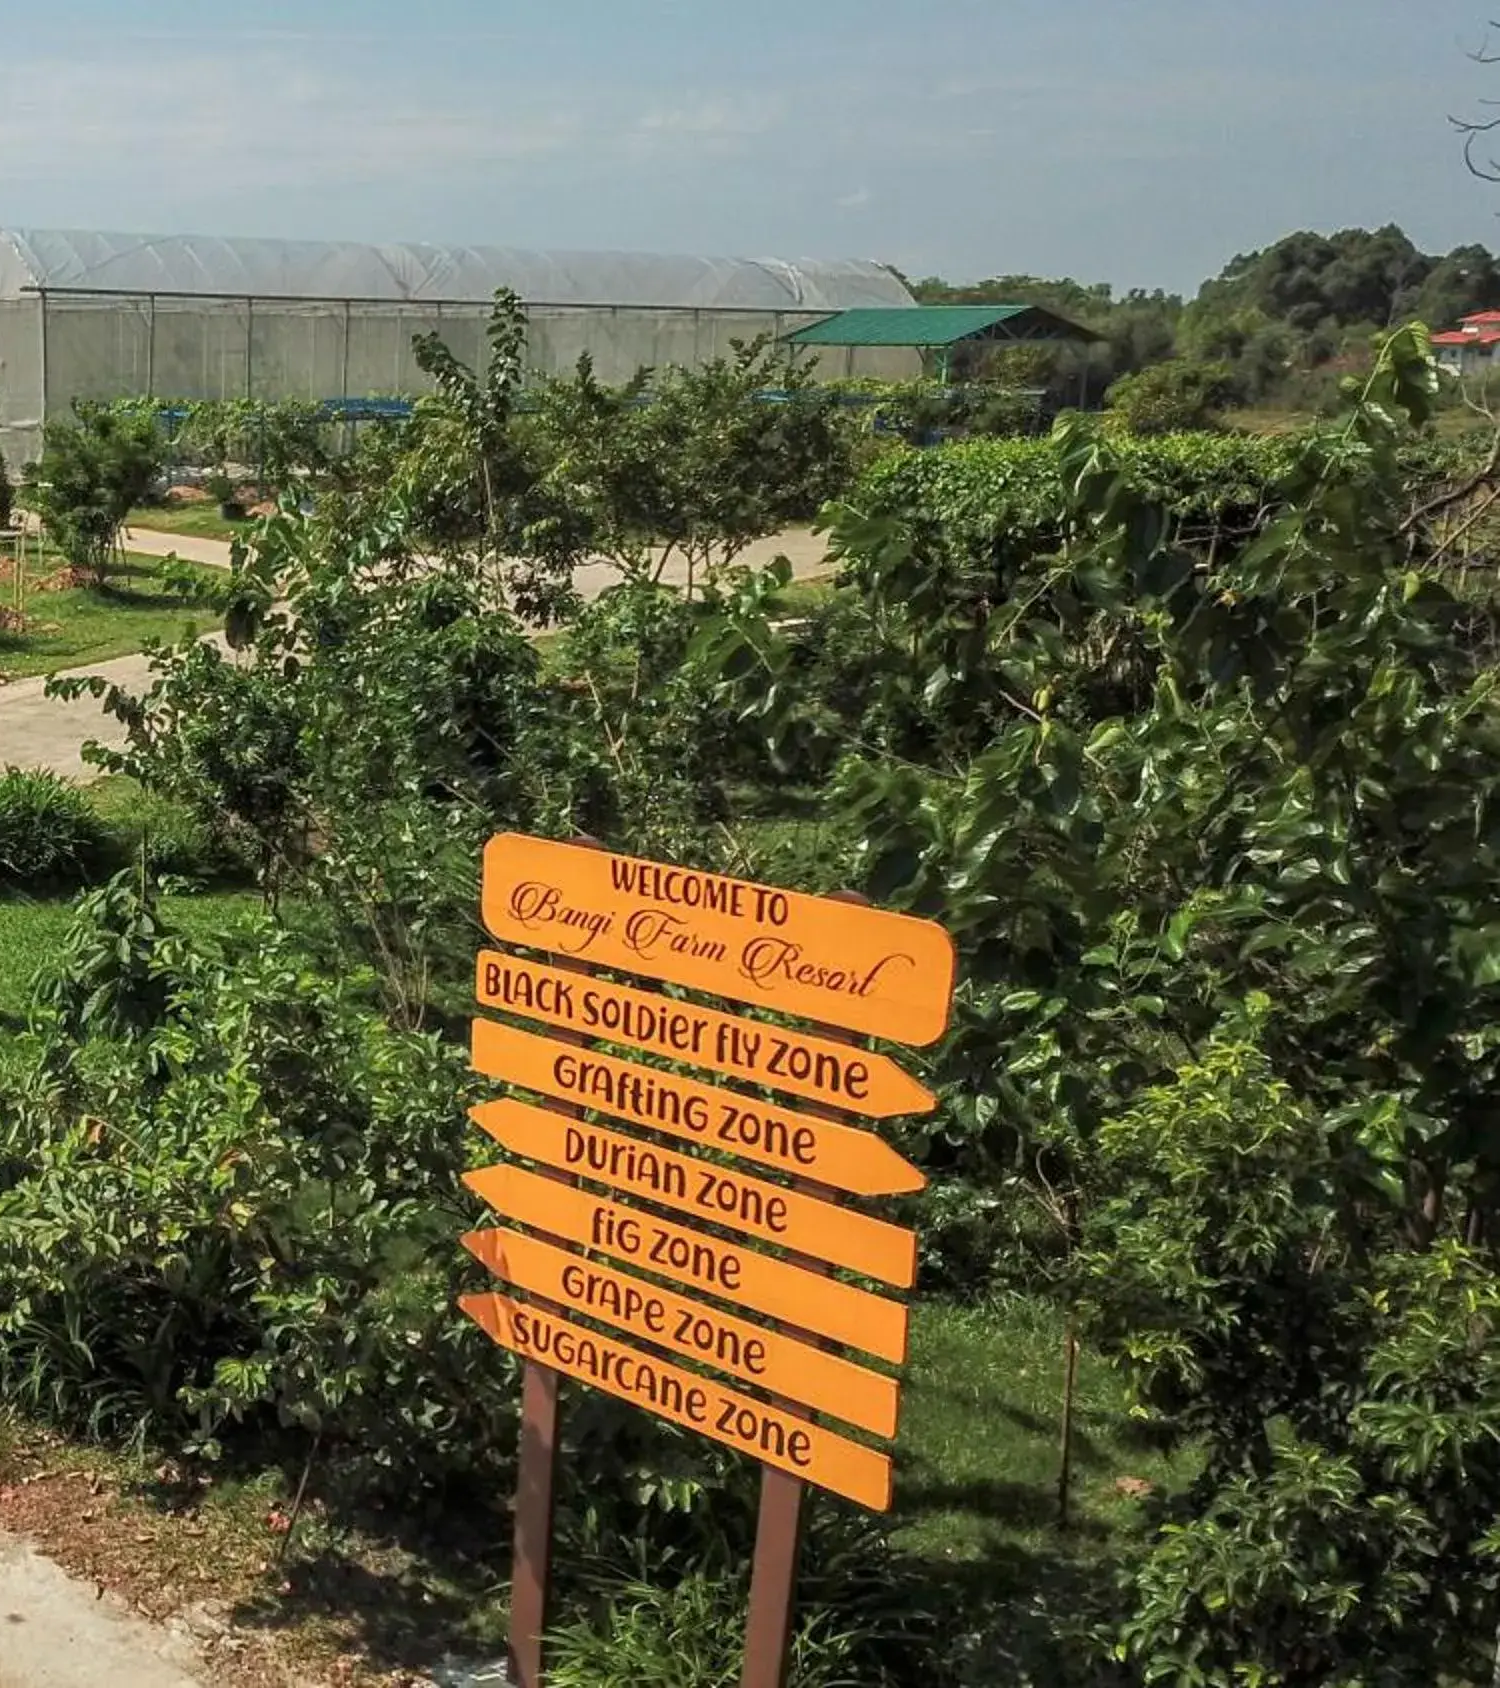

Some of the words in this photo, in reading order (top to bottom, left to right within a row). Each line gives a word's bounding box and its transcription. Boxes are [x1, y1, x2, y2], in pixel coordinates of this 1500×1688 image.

[612, 858, 744, 919] WELCOME
[754, 887, 789, 926] TO
[509, 881, 616, 954] Bangi
[621, 908, 727, 963] Farm
[737, 936, 916, 998] Resort
[485, 962, 573, 1020] BLACK
